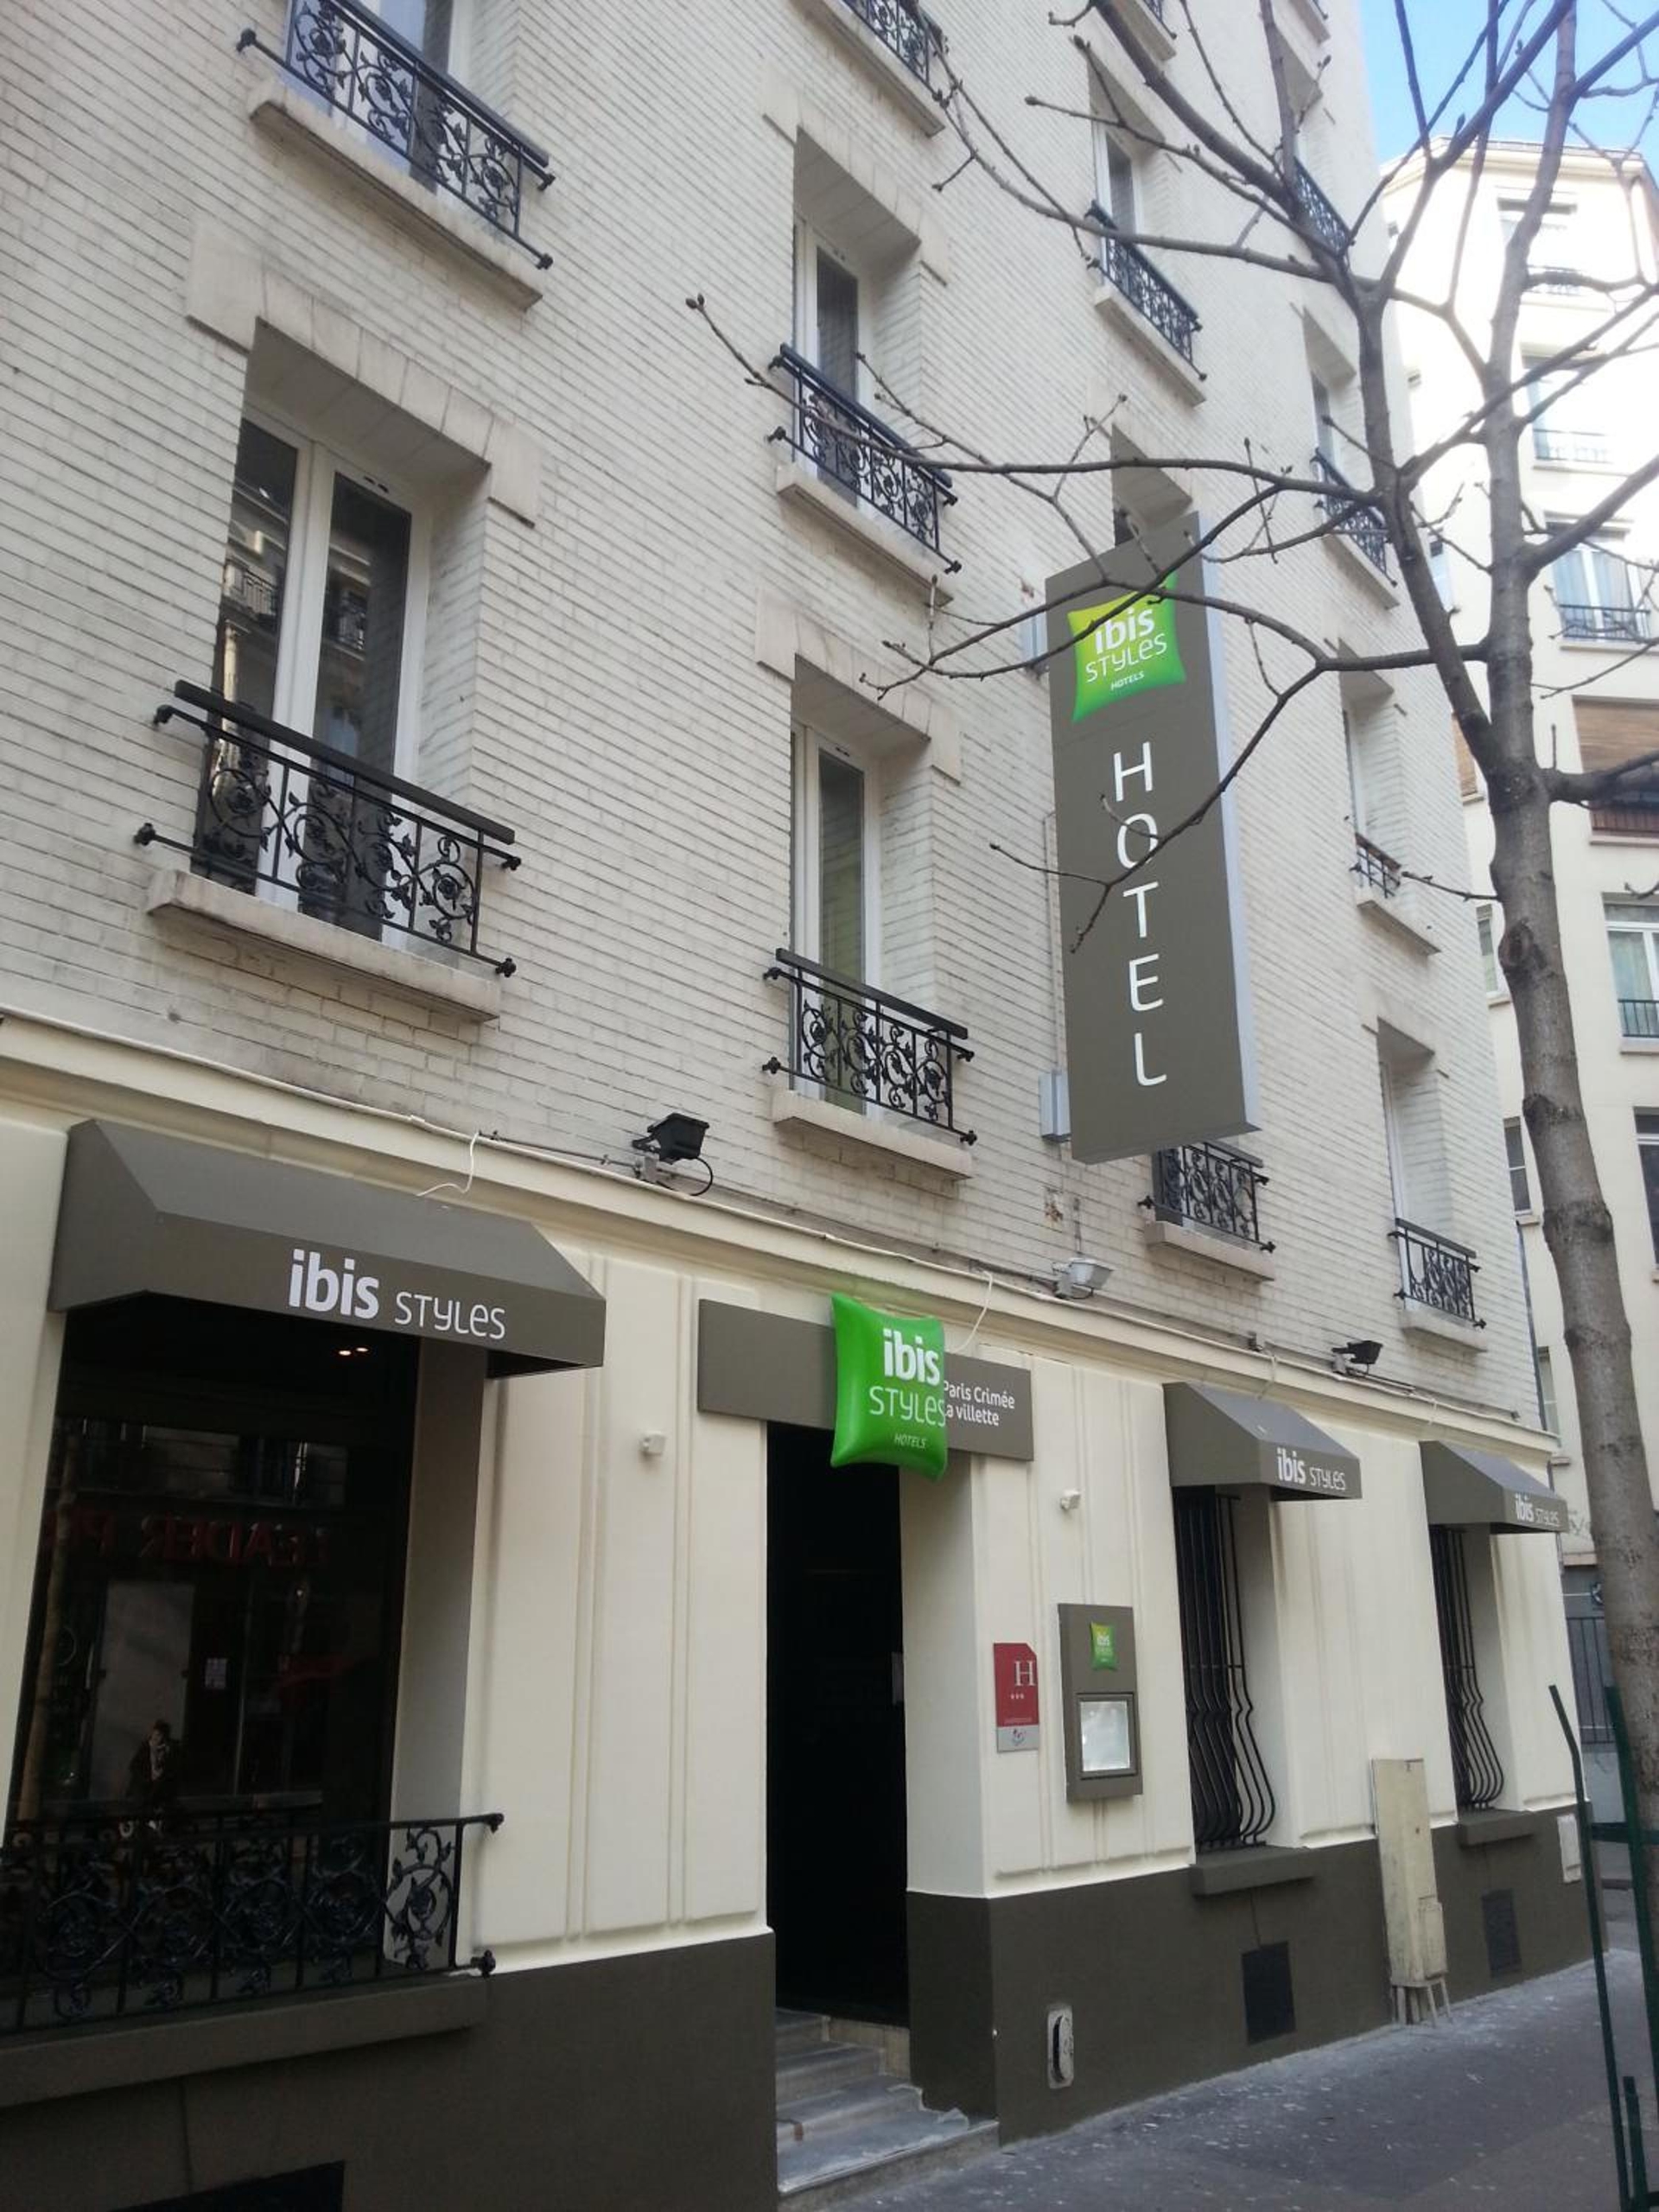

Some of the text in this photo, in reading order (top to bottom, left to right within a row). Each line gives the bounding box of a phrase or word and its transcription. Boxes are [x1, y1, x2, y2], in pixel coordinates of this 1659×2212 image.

[1095, 607, 1154, 654] ibis
[1110, 671, 1145, 691] HOTELS
[1112, 741, 1166, 1086] HOTEL
[289, 1249, 379, 1319] ibis
[883, 1328, 940, 1386] ibis
[974, 1386, 1015, 1409] Crimée
[956, 1403, 1000, 1427] villette
[893, 1433, 927, 1449] HOTELS
[1276, 1447, 1307, 1484] ibis
[1515, 1493, 1534, 1522] ibis
[1014, 1660, 1037, 1686] H
